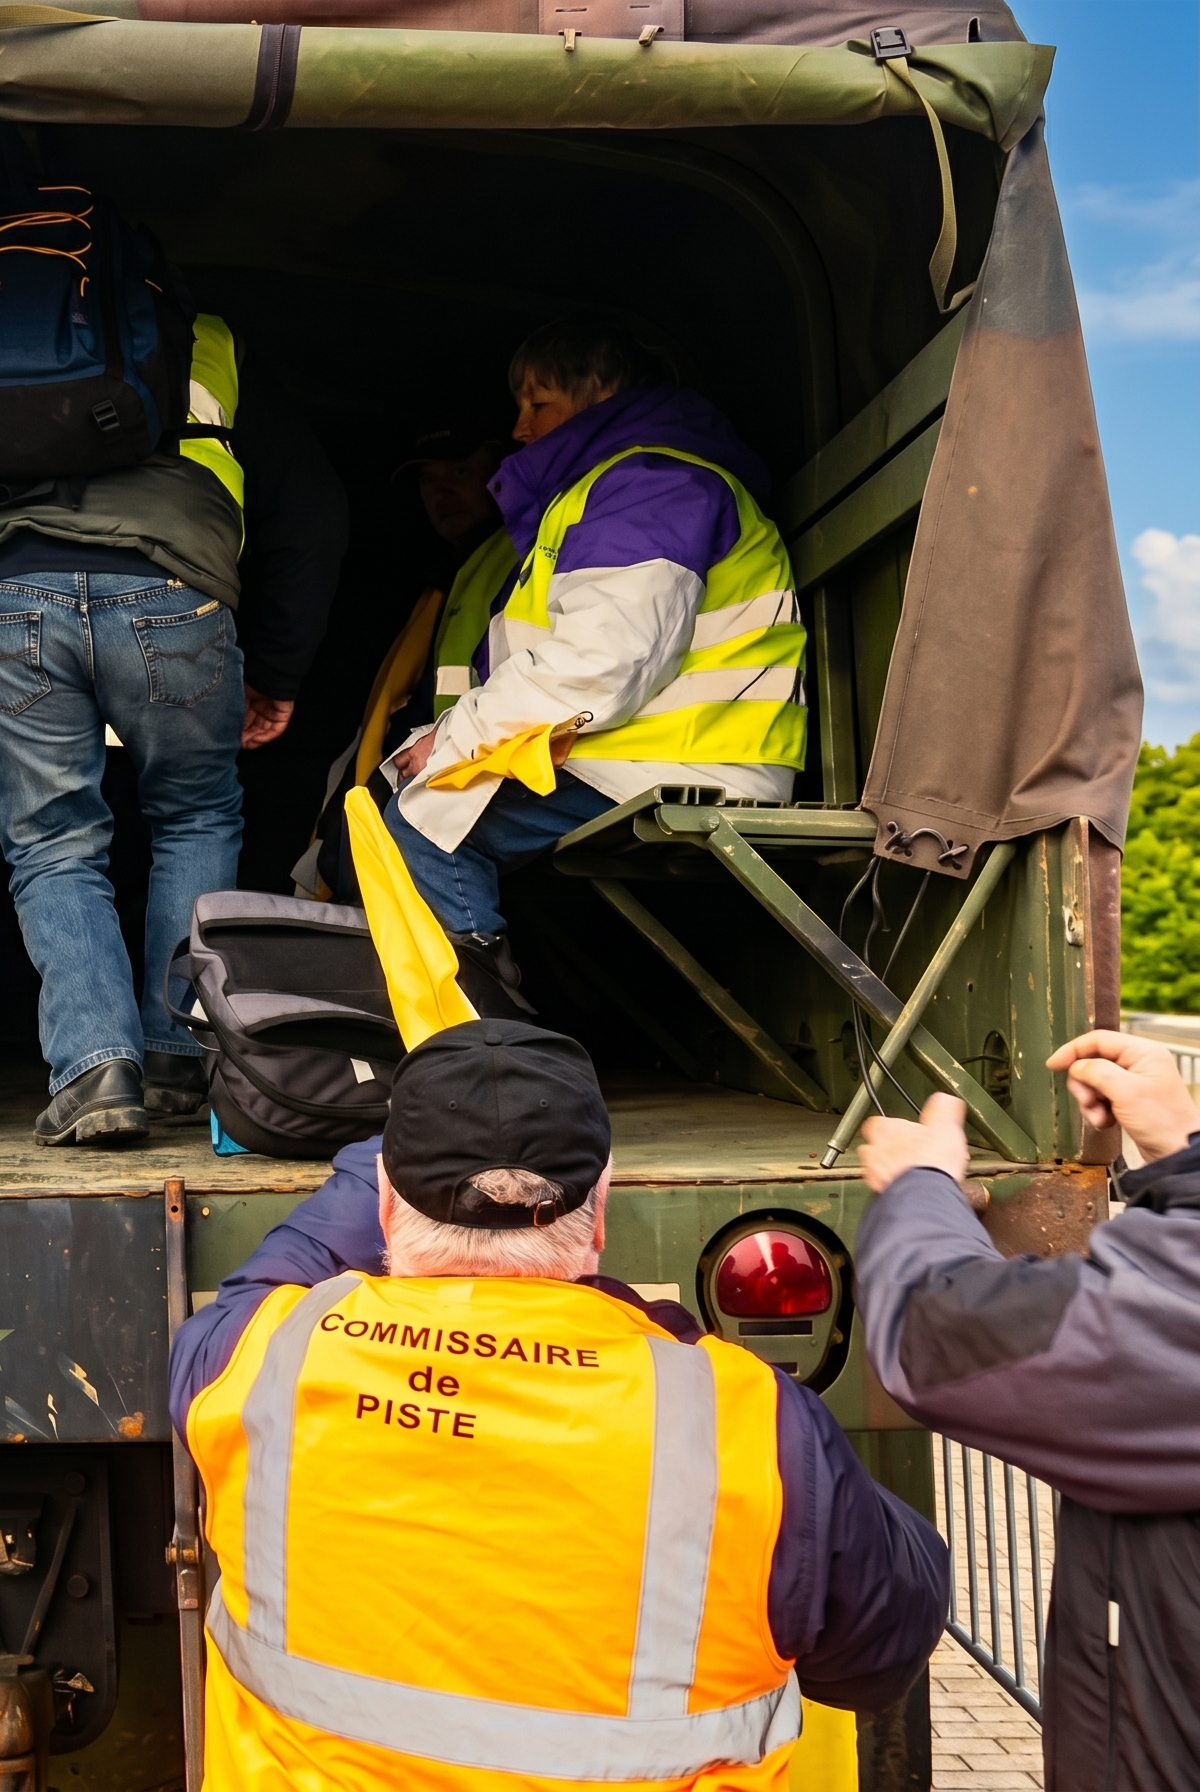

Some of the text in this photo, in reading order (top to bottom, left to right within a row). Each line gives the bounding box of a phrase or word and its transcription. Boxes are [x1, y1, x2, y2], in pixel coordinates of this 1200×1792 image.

[320, 1313, 600, 1368] COMMISSAIRE
[408, 1366, 460, 1397] de
[355, 1393, 477, 1439] PISTE
